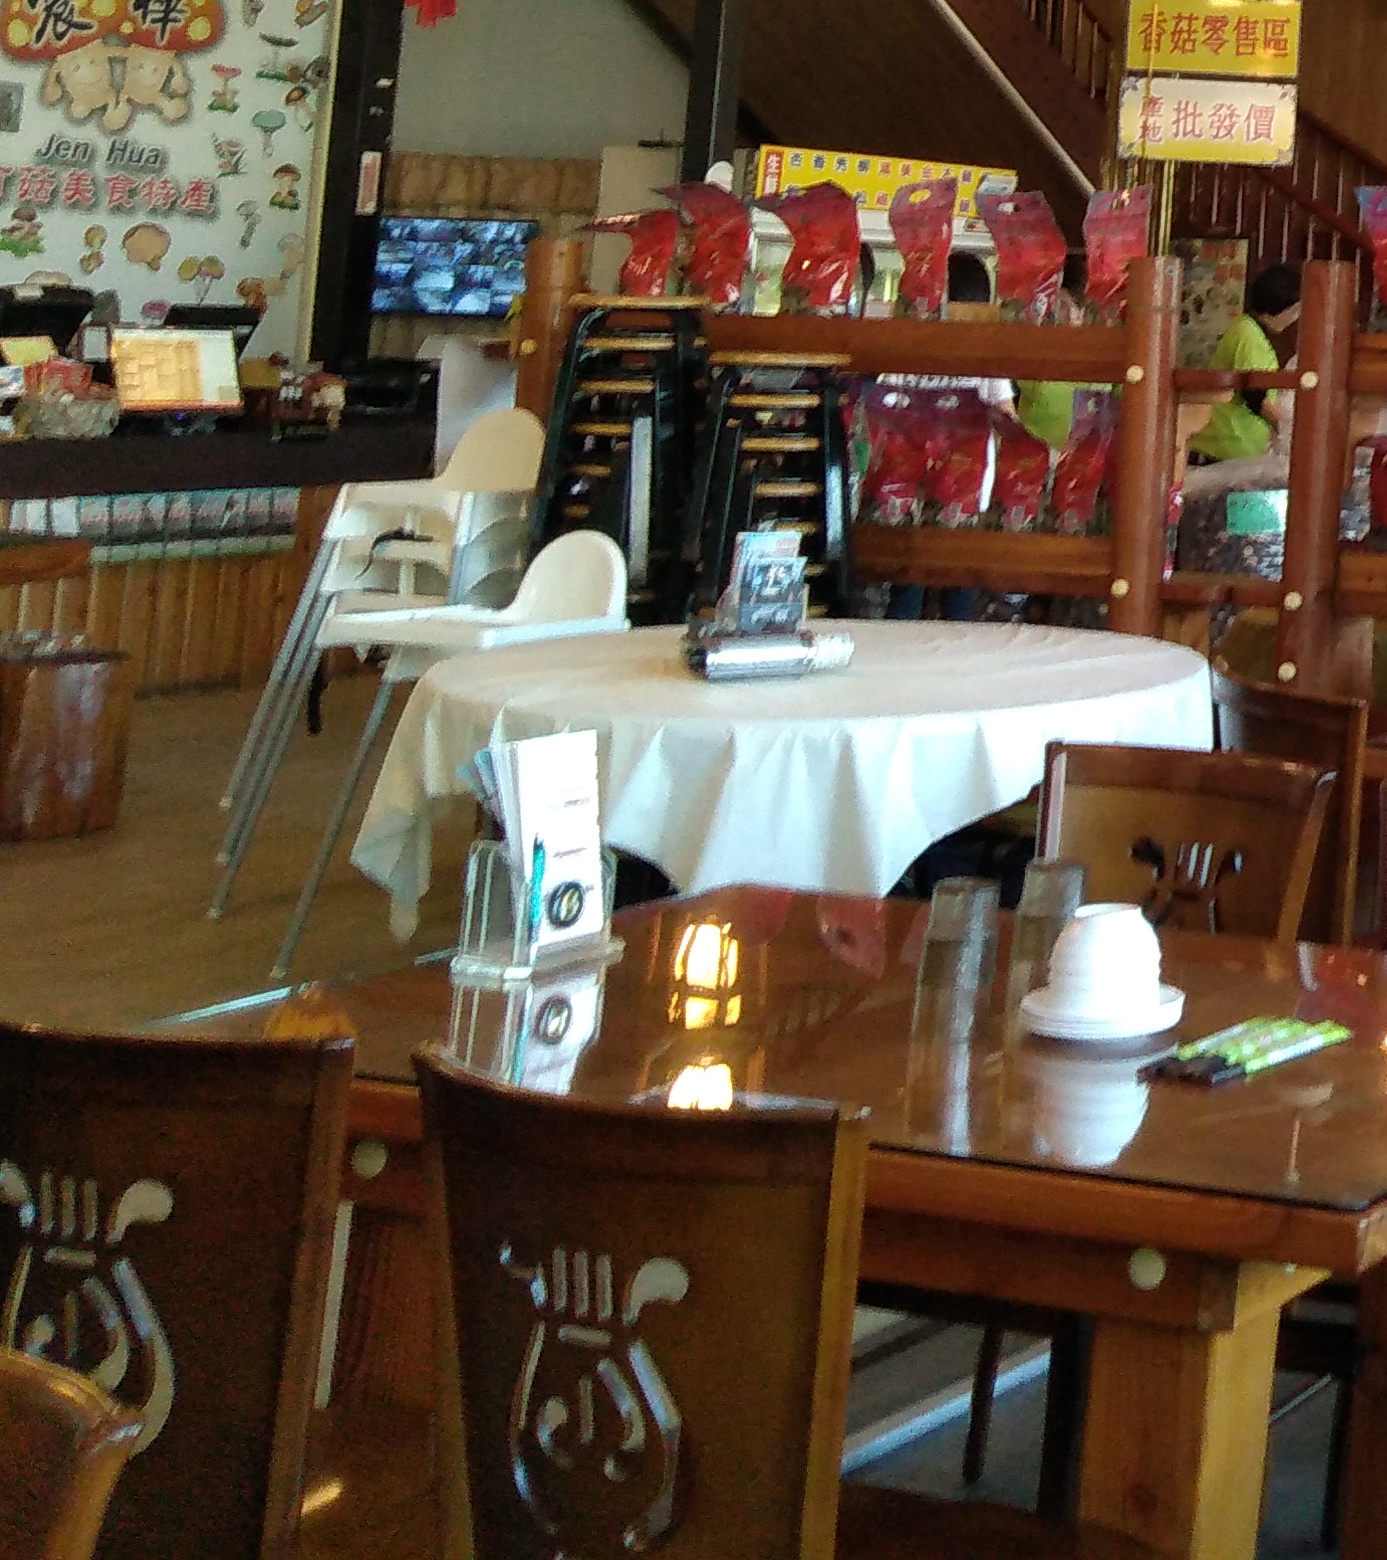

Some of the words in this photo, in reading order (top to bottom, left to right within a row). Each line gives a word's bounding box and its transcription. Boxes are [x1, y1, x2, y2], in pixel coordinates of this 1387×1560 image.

[1138, 9, 1292, 59] 香菇零售區
[36, 132, 91, 163] Jen
[105, 138, 163, 167] Hua
